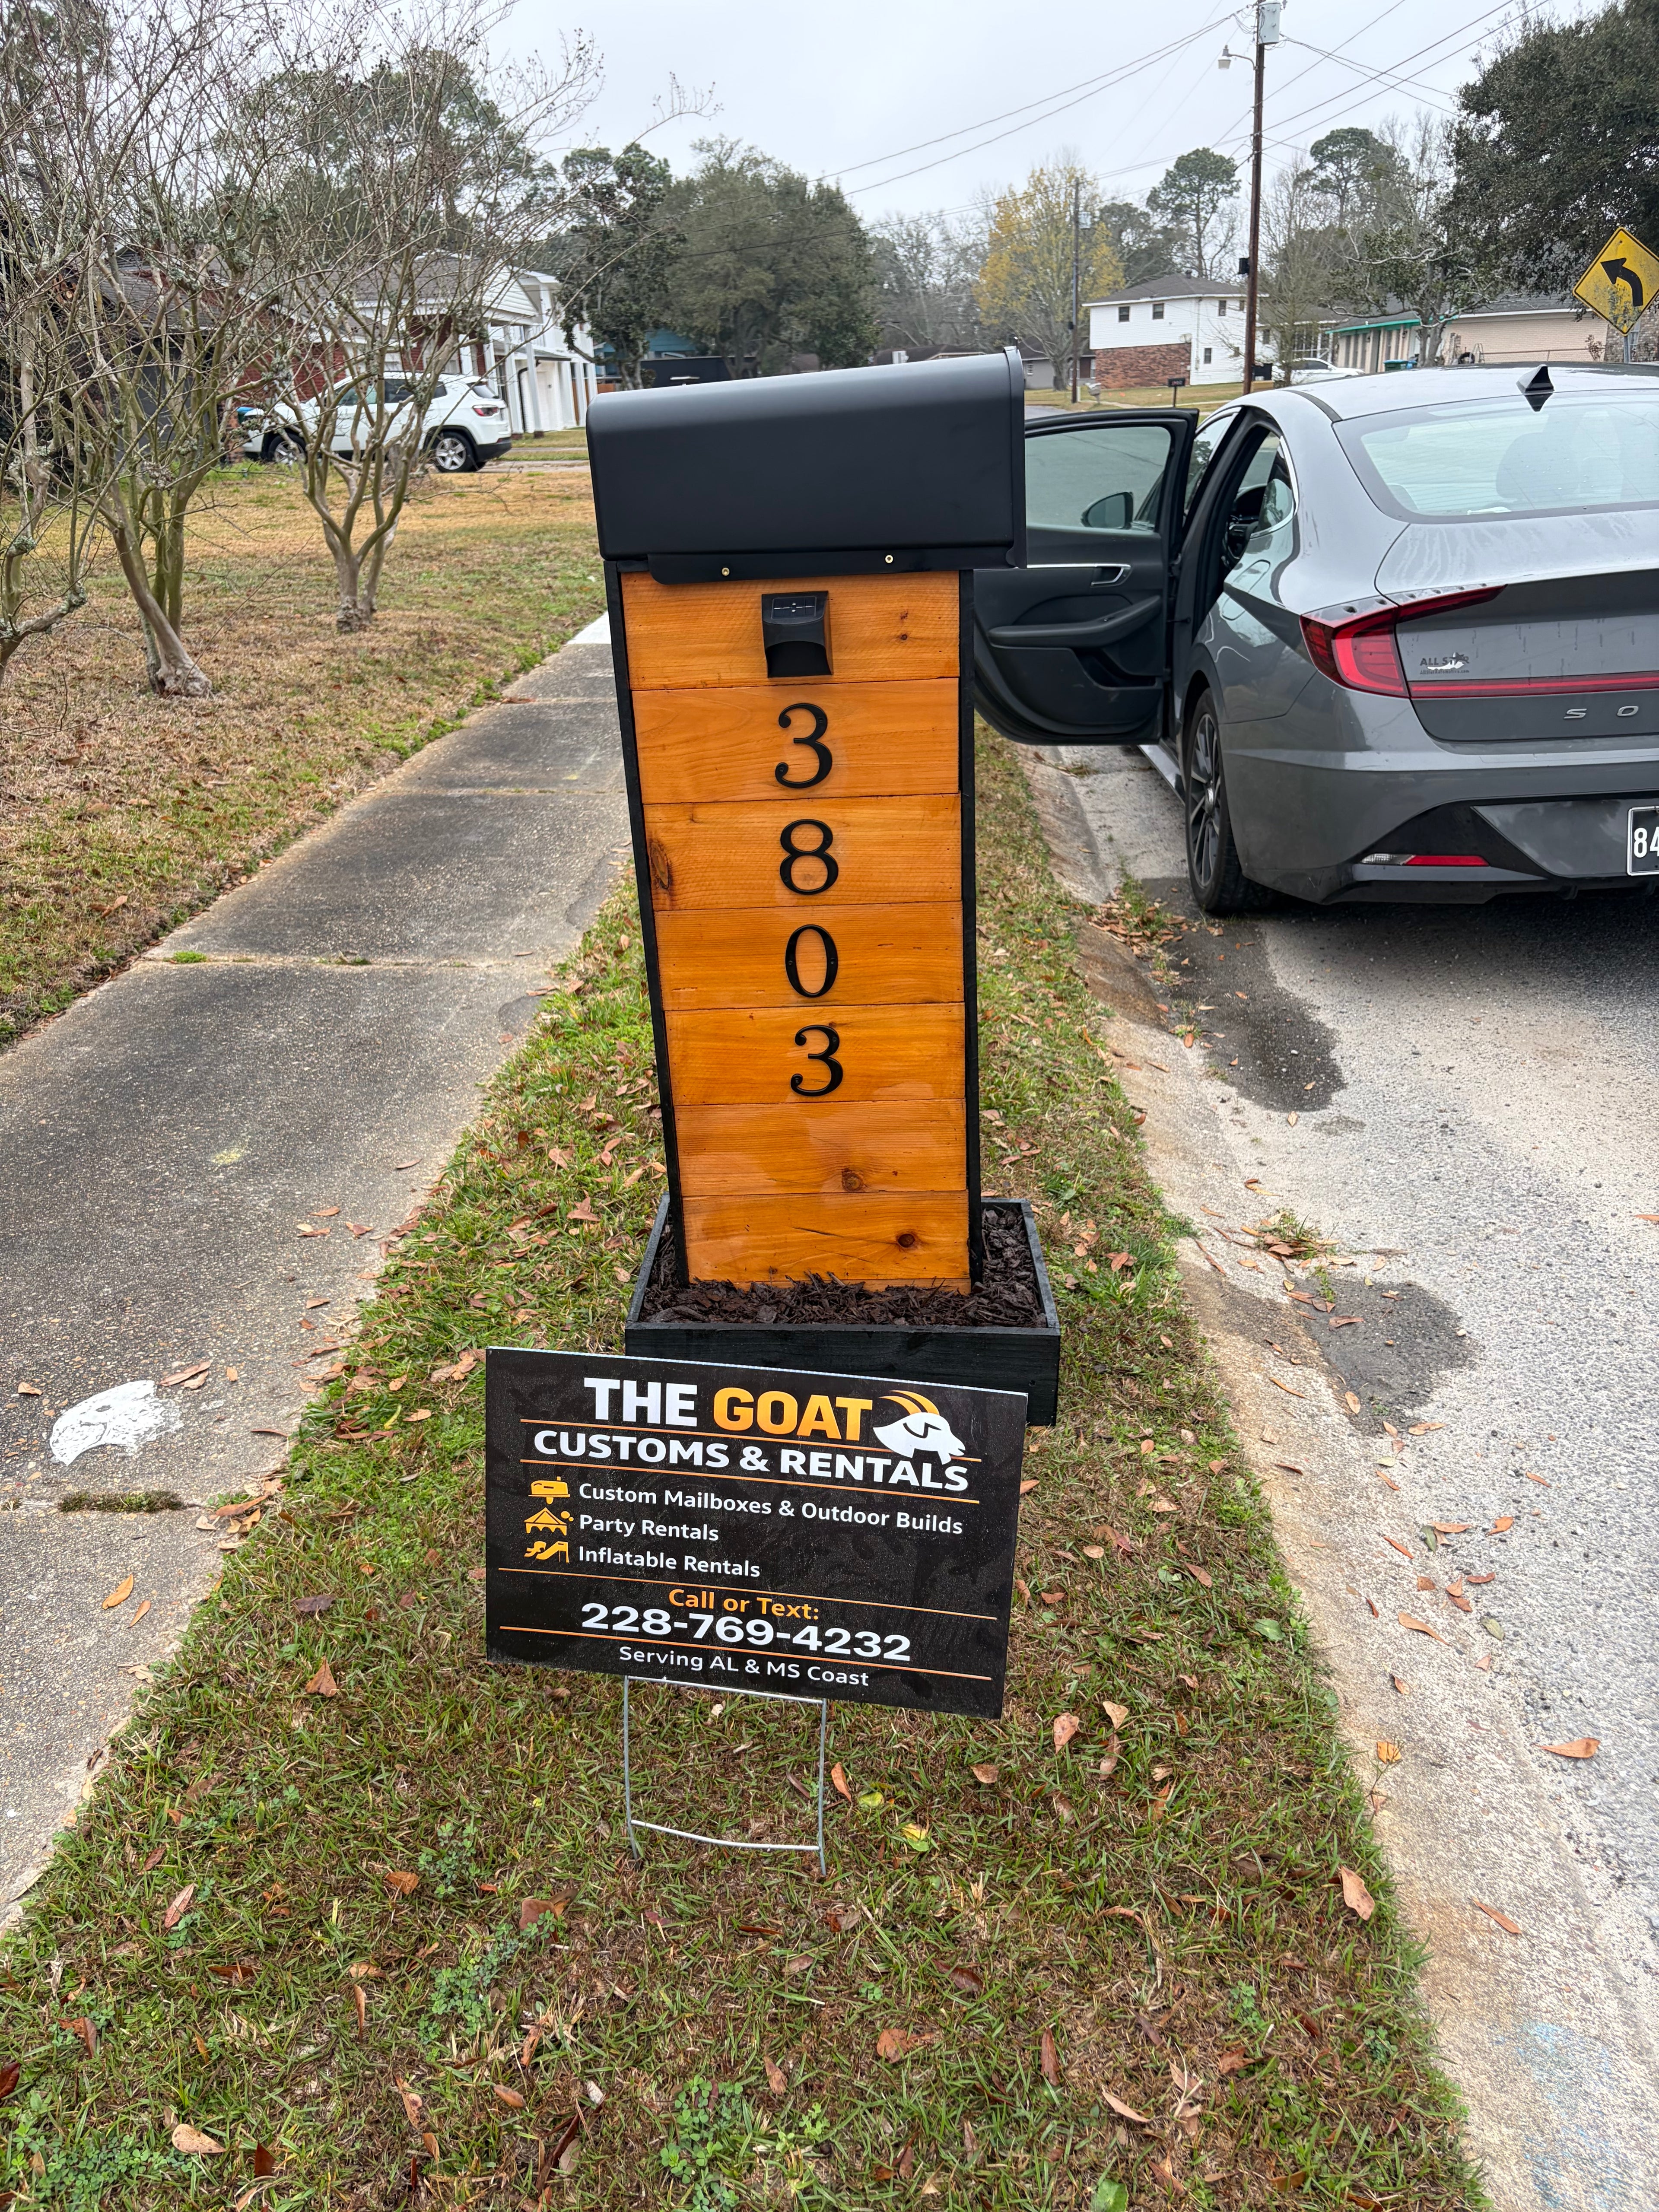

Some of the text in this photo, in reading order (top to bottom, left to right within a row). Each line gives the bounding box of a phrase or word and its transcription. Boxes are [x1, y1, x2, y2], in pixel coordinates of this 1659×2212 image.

[1420, 658, 1439, 666] ALL
[584, 1377, 873, 1441] THE GOAT
[534, 1430, 968, 1491] CUSTOMS & RENTALS
[579, 1483, 963, 1535] Custom Mailboxes & Outdoor Builds
[580, 1514, 719, 1541] Party Rentals
[579, 1546, 760, 1578] Inflatable Rentals
[669, 1589, 819, 1621] Call or Text:
[582, 1603, 911, 1662] 228-769-4232
[620, 1646, 869, 1687] Serving AL & MS Coast
